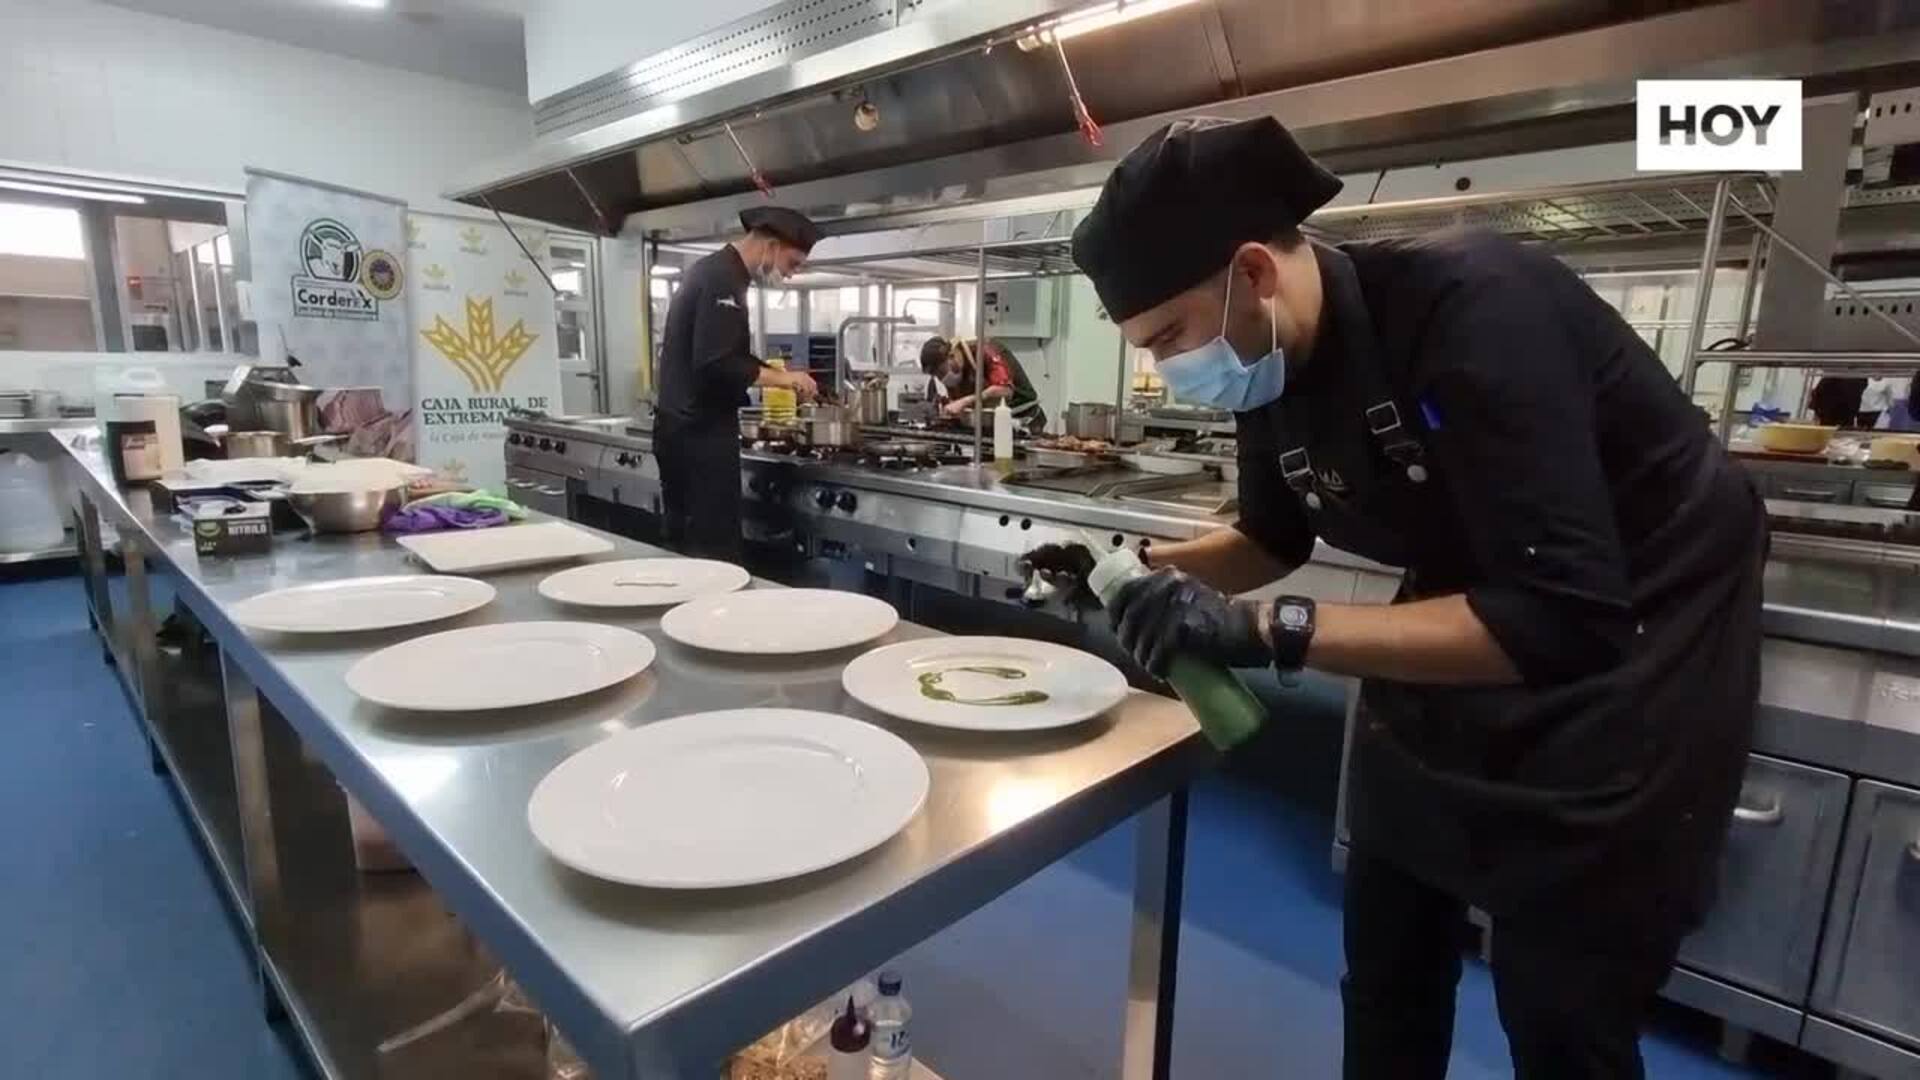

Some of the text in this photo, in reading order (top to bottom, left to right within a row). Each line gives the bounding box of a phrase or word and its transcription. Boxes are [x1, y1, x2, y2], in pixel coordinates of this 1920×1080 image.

[421, 396, 549, 411] CAJA RURAL DE
[423, 411, 506, 426] EXTREMA
